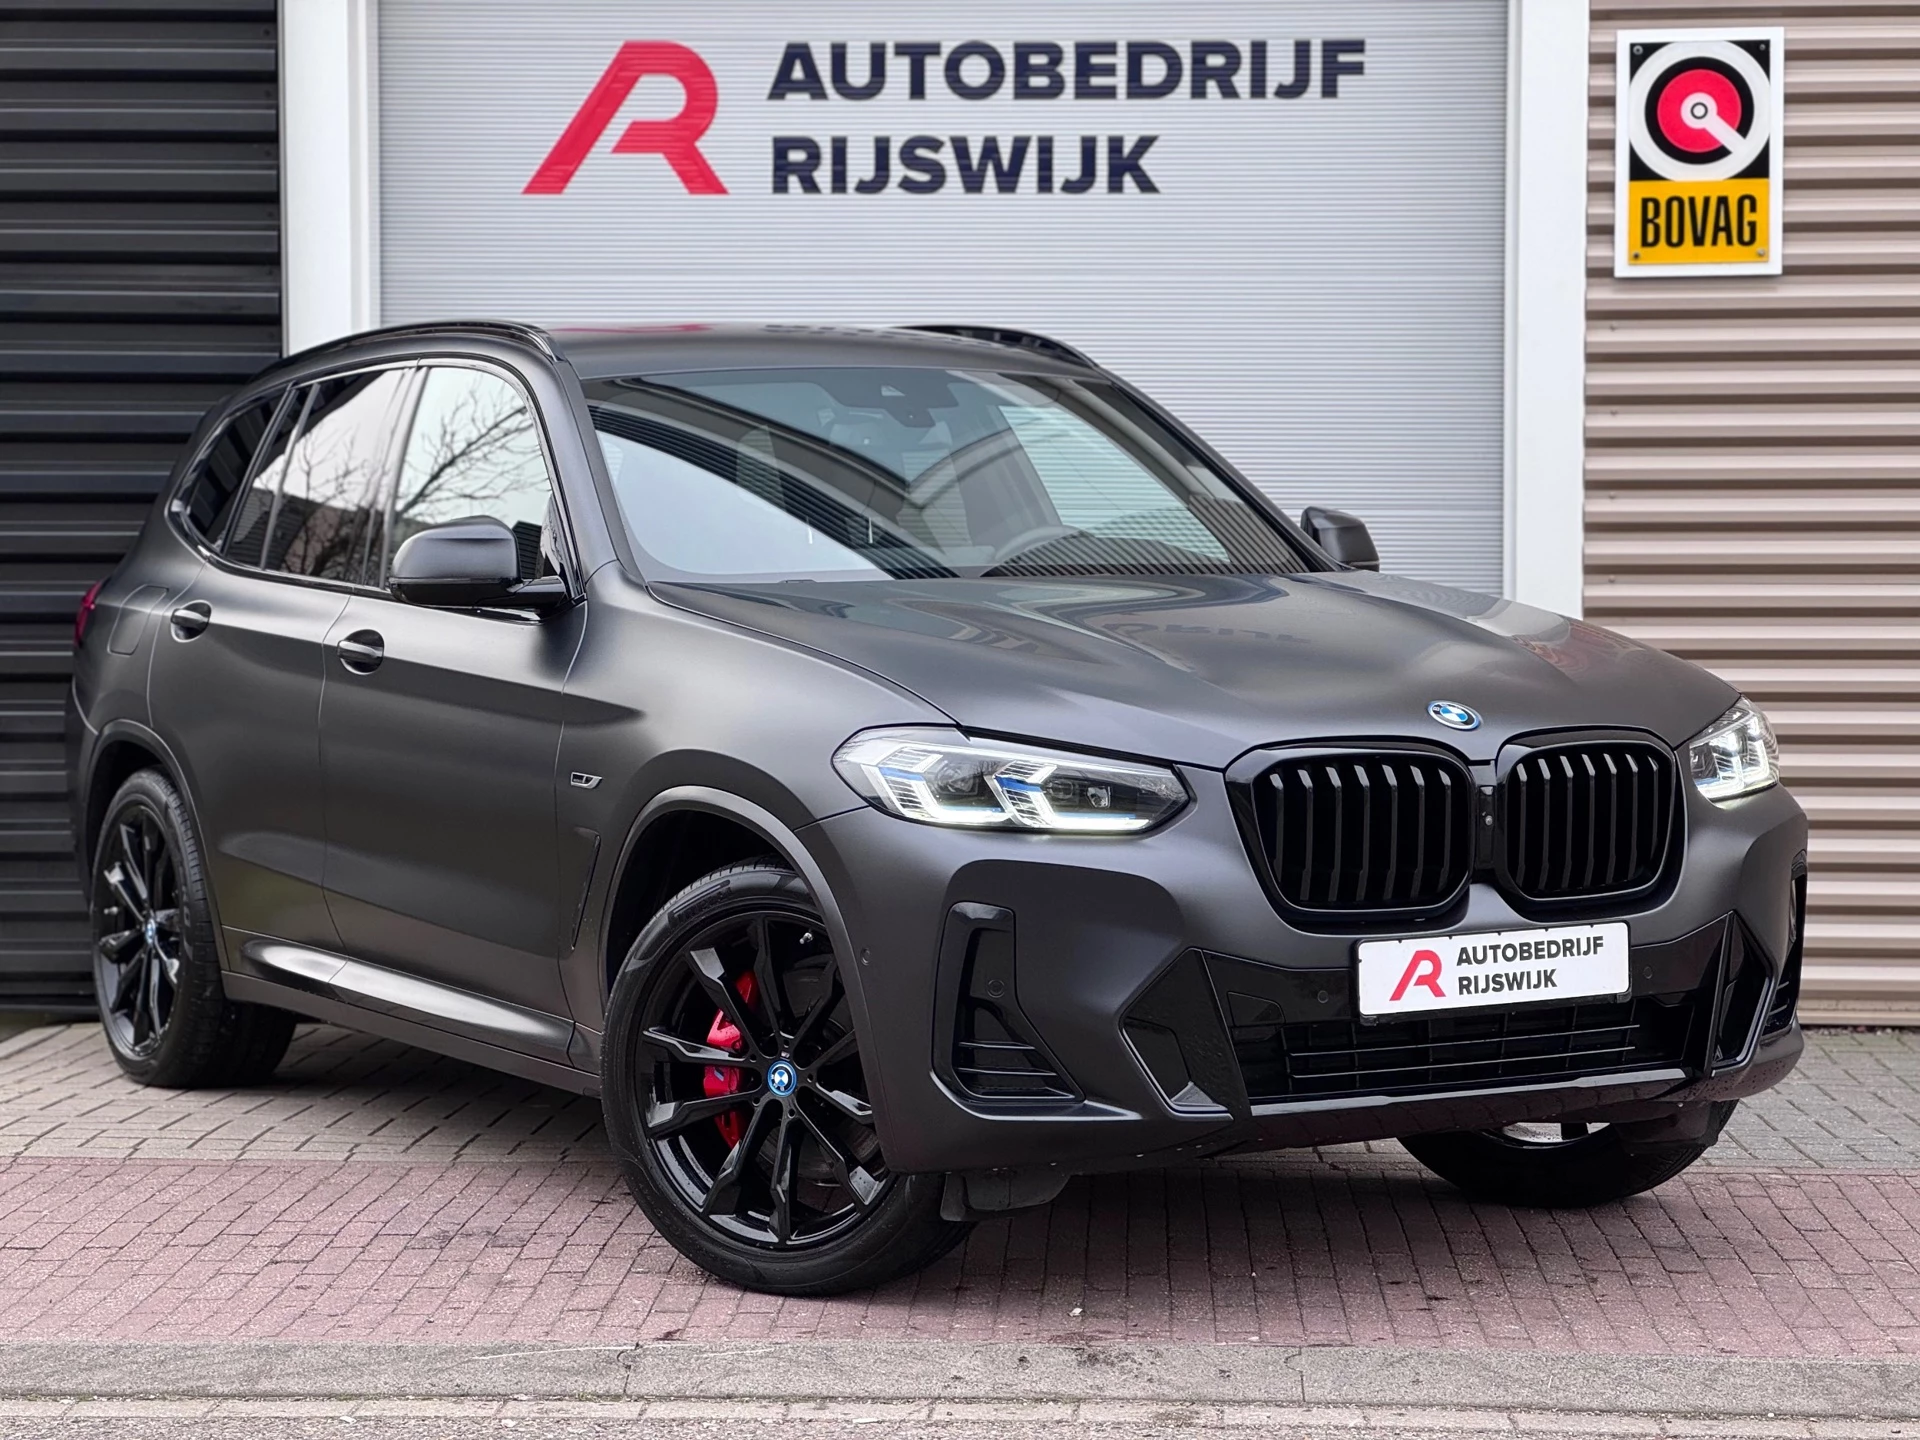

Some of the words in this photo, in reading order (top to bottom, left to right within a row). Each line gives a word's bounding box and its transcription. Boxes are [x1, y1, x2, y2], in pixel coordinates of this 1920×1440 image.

[768, 39, 1366, 101] AUTOBEDRIJF
[772, 136, 1160, 195] RIJSWIJK
[1641, 194, 1757, 248] BOVAG
[1456, 936, 1604, 966] AUTOBEDRIJF
[1457, 968, 1558, 996] RIJSWIJK
